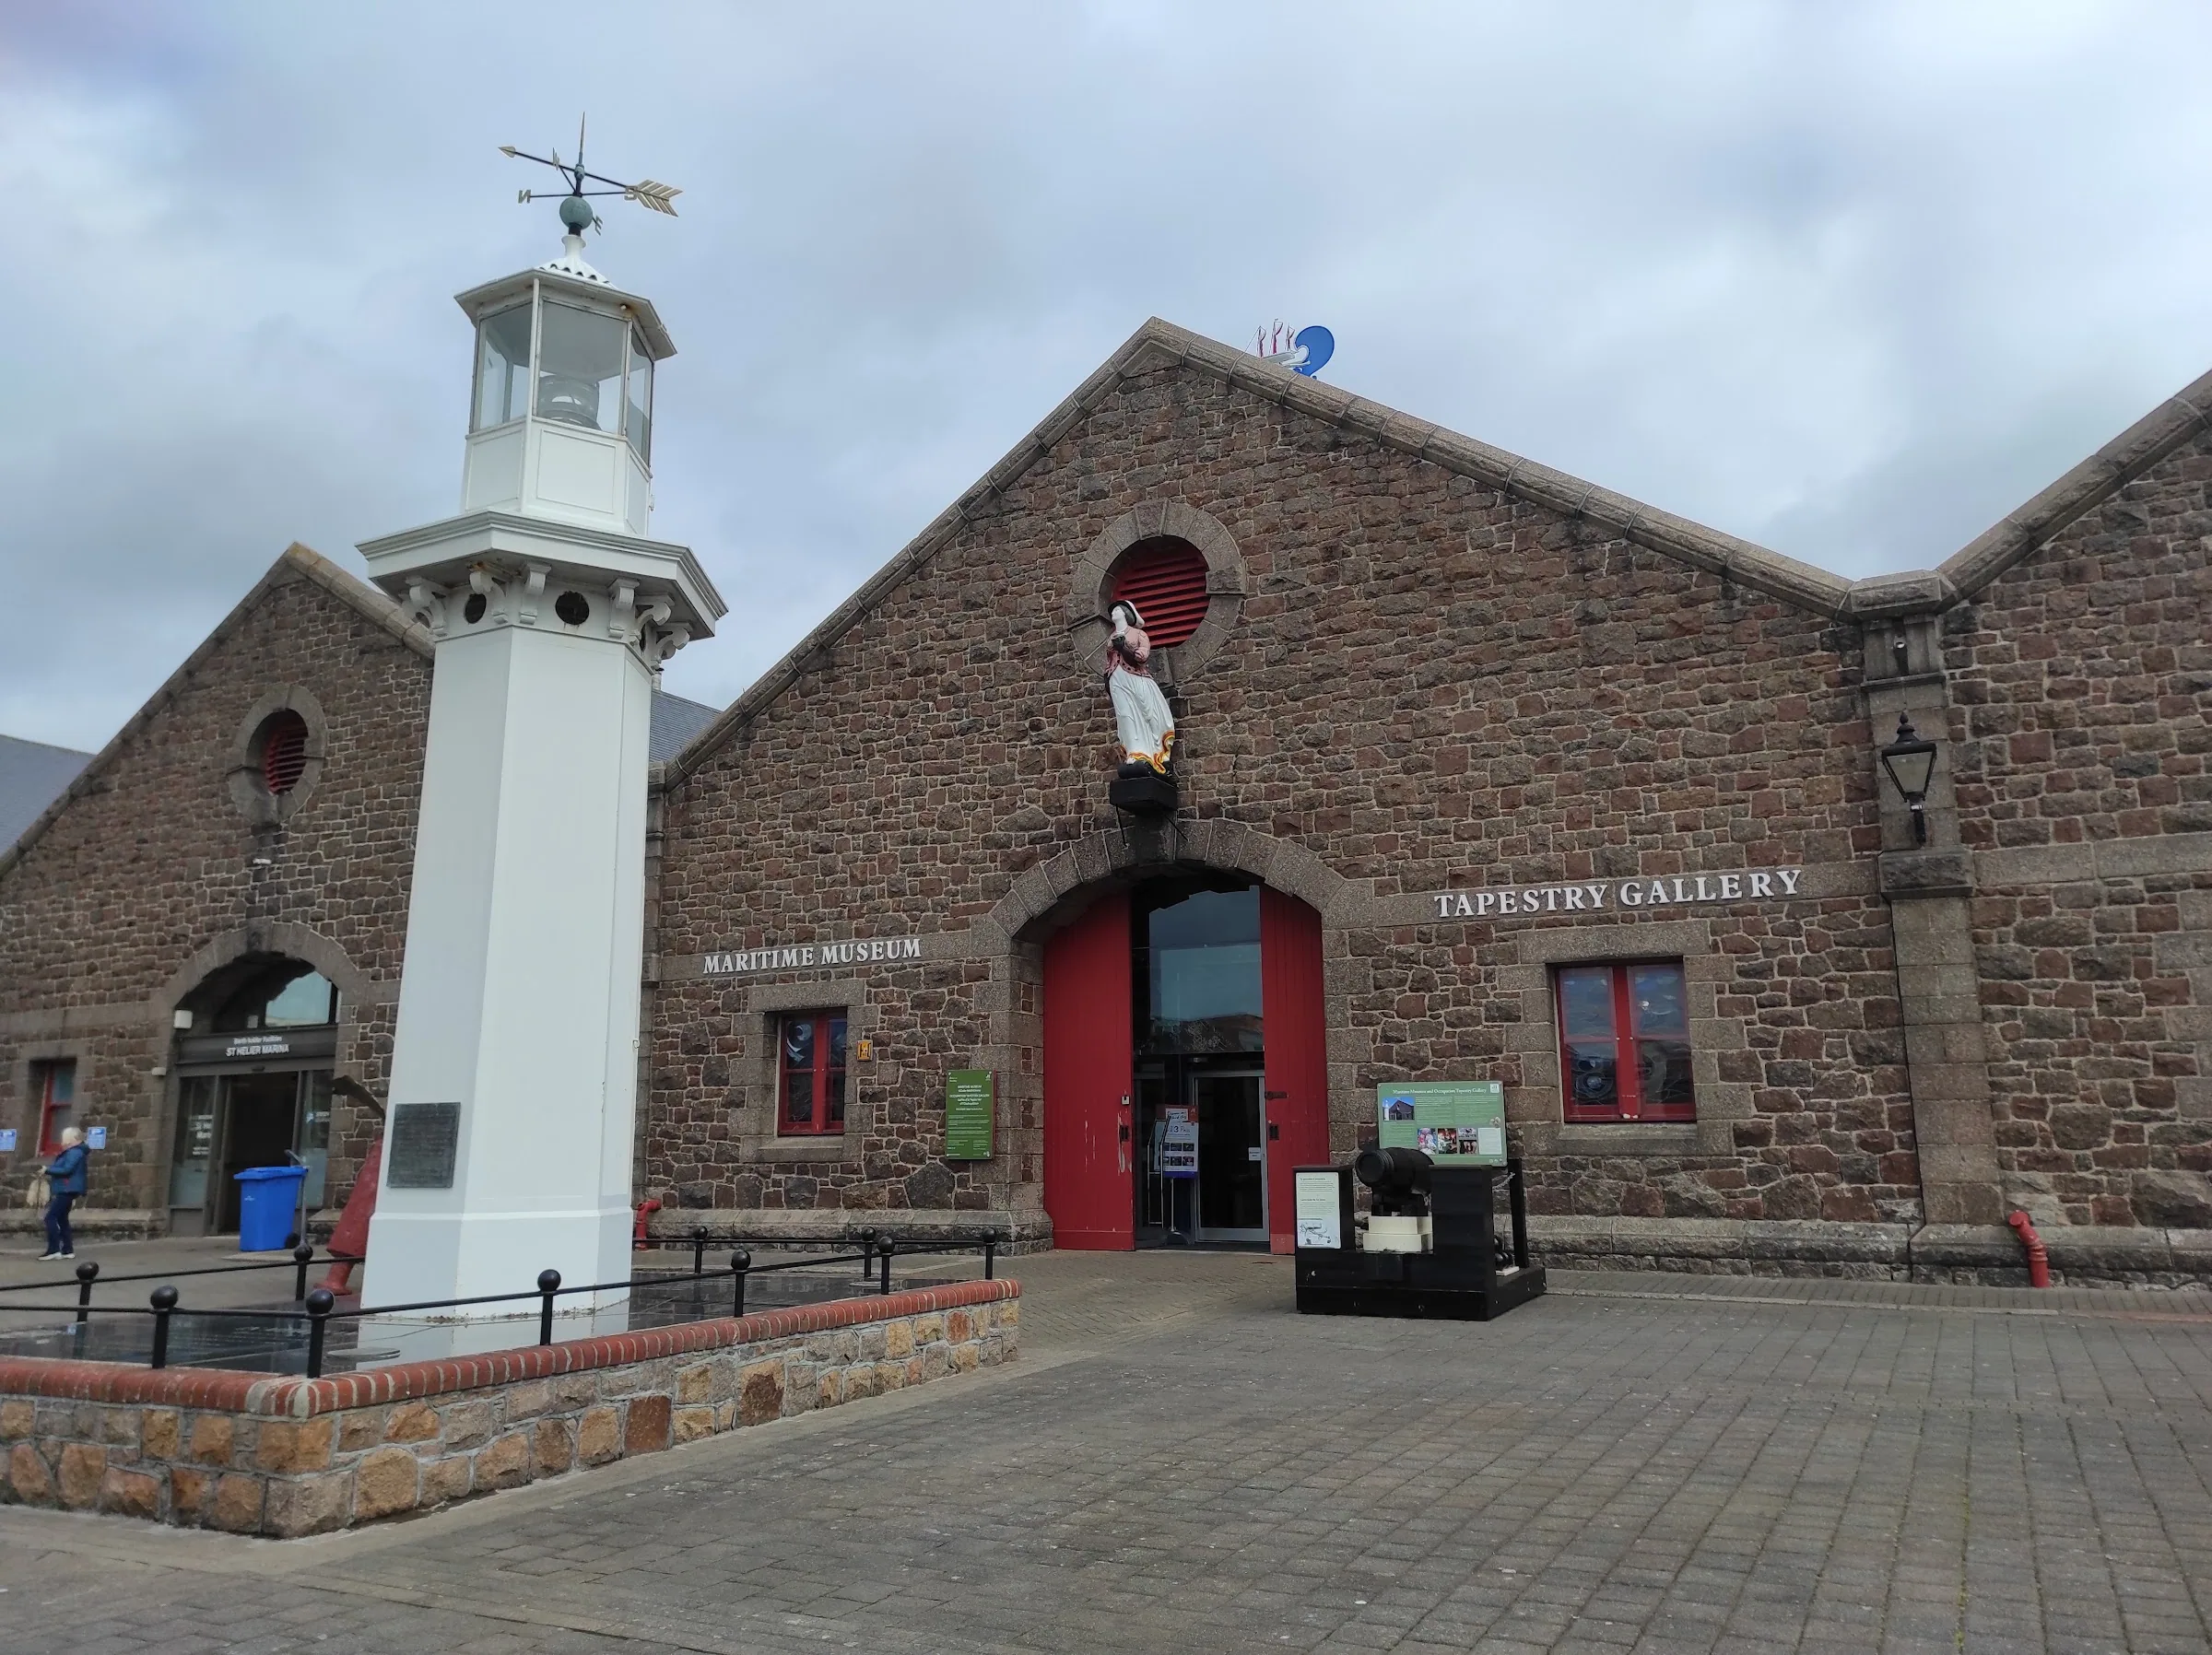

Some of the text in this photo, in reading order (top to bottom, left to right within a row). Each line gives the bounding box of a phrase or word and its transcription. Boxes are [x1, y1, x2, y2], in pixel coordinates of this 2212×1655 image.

[1434, 869, 1801, 918] TAPESTRY GALLERY
[703, 938, 922, 973] MARITIME MUSEUM
[226, 1047, 236, 1056] ST
